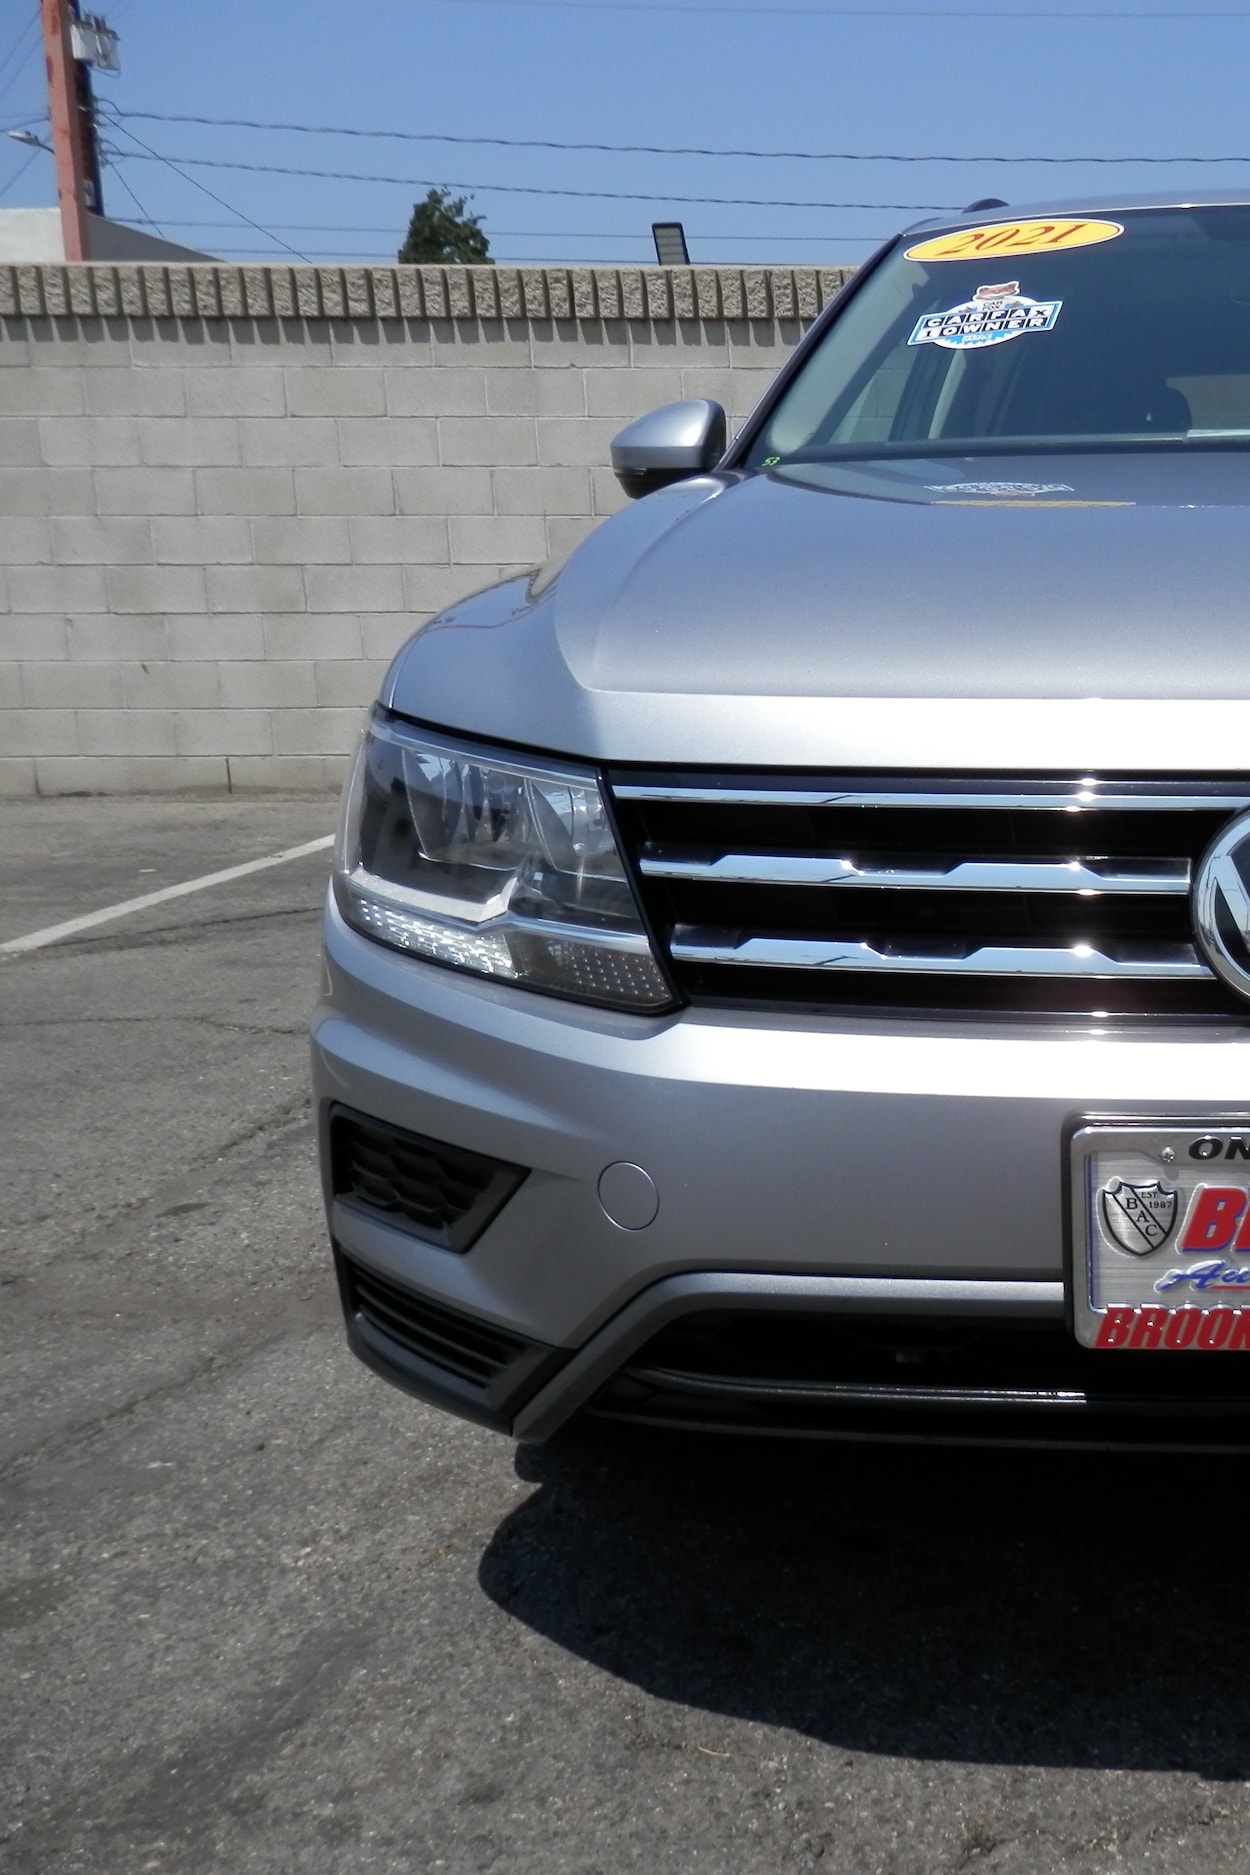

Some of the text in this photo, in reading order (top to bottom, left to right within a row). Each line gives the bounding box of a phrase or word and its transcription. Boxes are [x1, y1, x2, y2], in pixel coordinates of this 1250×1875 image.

[934, 223, 1088, 256] 2021
[927, 309, 1048, 327] CARFAX
[943, 318, 1043, 336] OWNER
[1149, 1200, 1173, 1209] 1987
